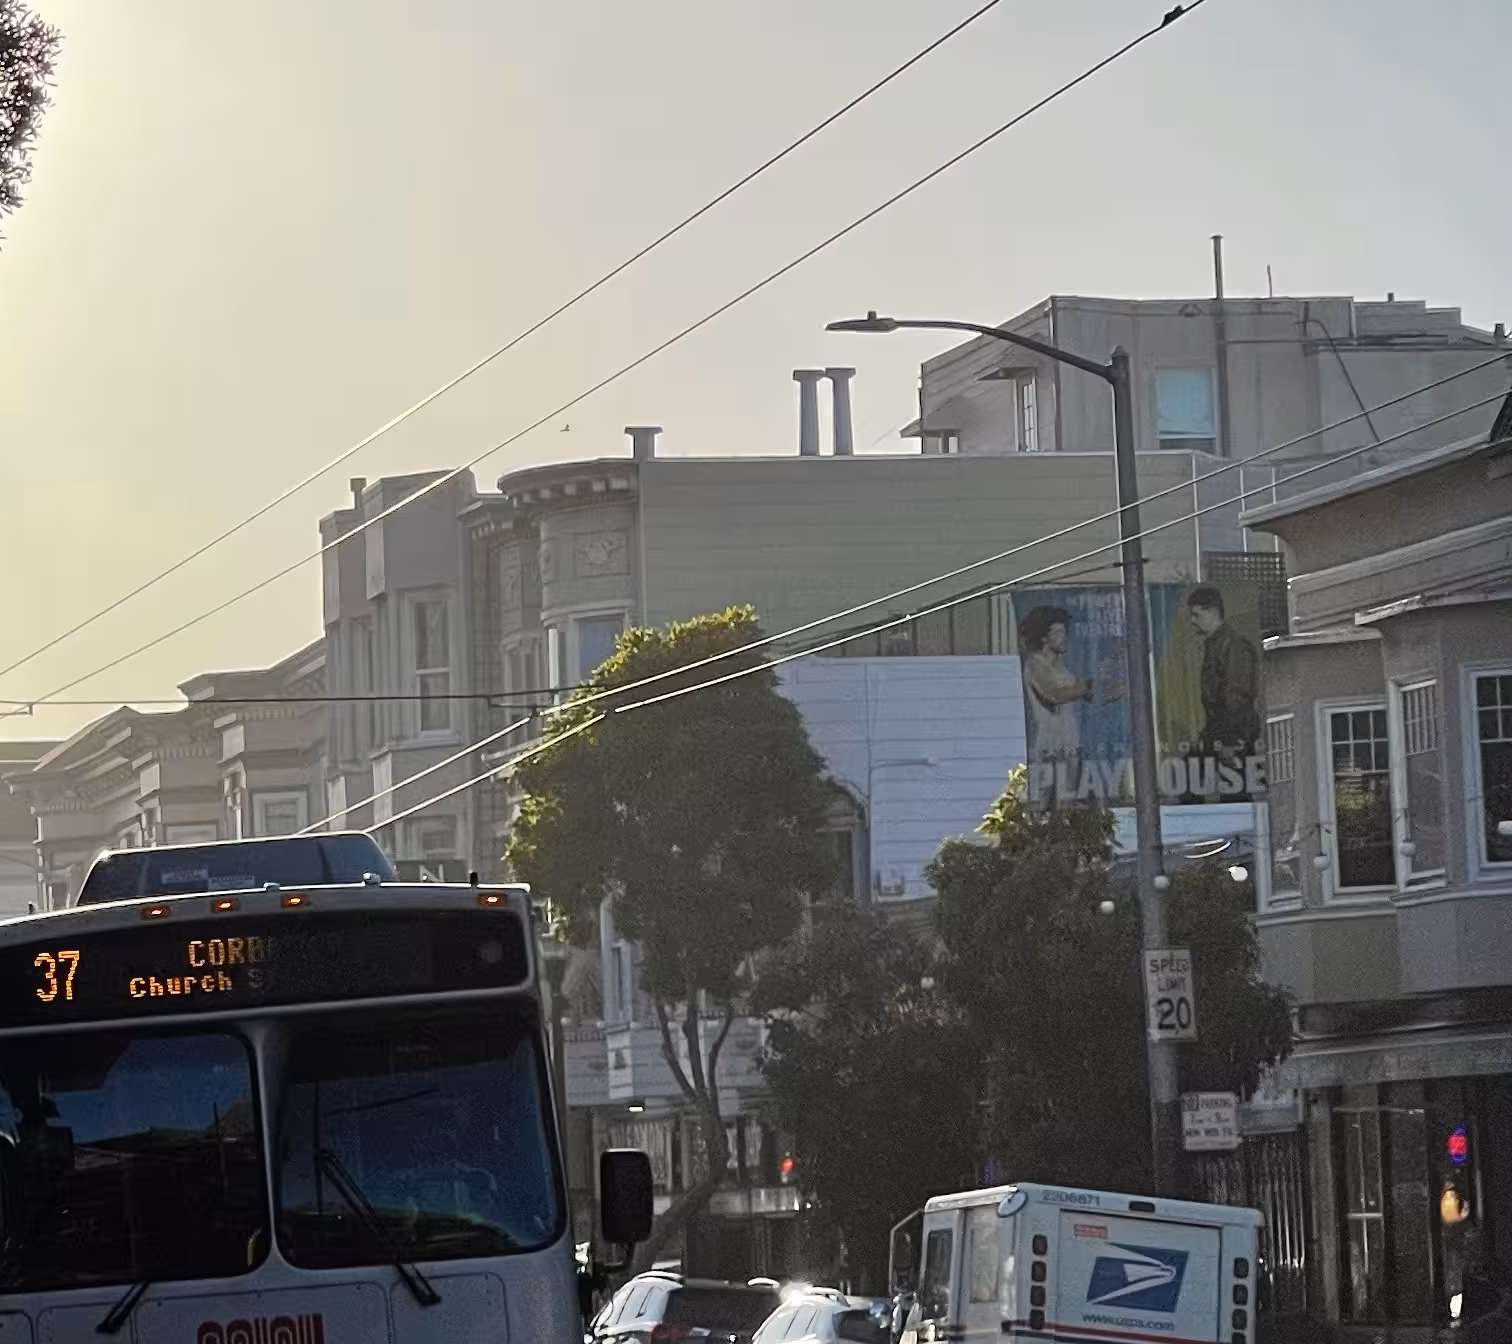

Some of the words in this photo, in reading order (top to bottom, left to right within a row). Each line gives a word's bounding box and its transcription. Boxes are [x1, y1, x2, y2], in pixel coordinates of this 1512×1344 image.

[1029, 757, 1269, 801] PLAYOUSE
[33, 950, 80, 1002] 37
[129, 970, 233, 999] Church
[1156, 996, 1192, 1030] 20
